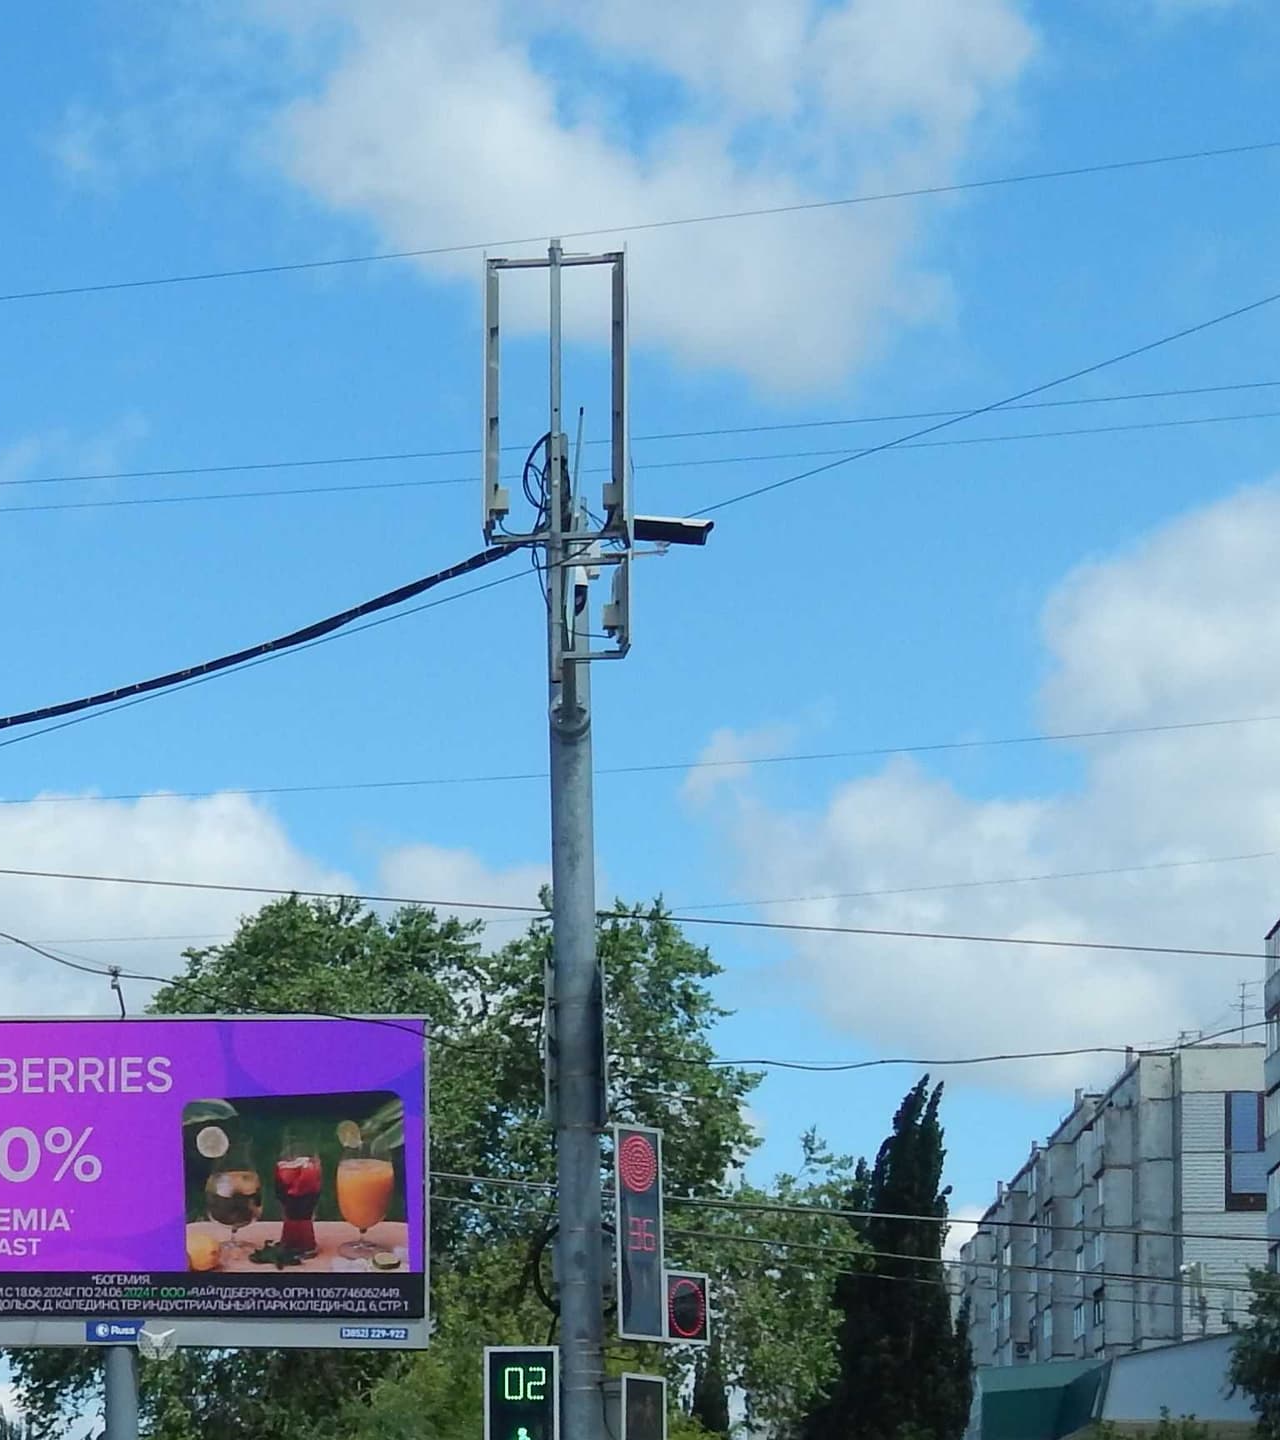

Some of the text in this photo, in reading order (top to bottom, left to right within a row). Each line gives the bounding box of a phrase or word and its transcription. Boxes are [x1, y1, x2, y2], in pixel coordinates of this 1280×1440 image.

[76, 1286, 93, 1297] ПО
[160, 1287, 186, 1298] ООО
[283, 1287, 314, 1299] ОГРН
[256, 1300, 290, 1311] ПАРК
[110, 1325, 137, 1336] Russ
[503, 1366, 547, 1401] 02
